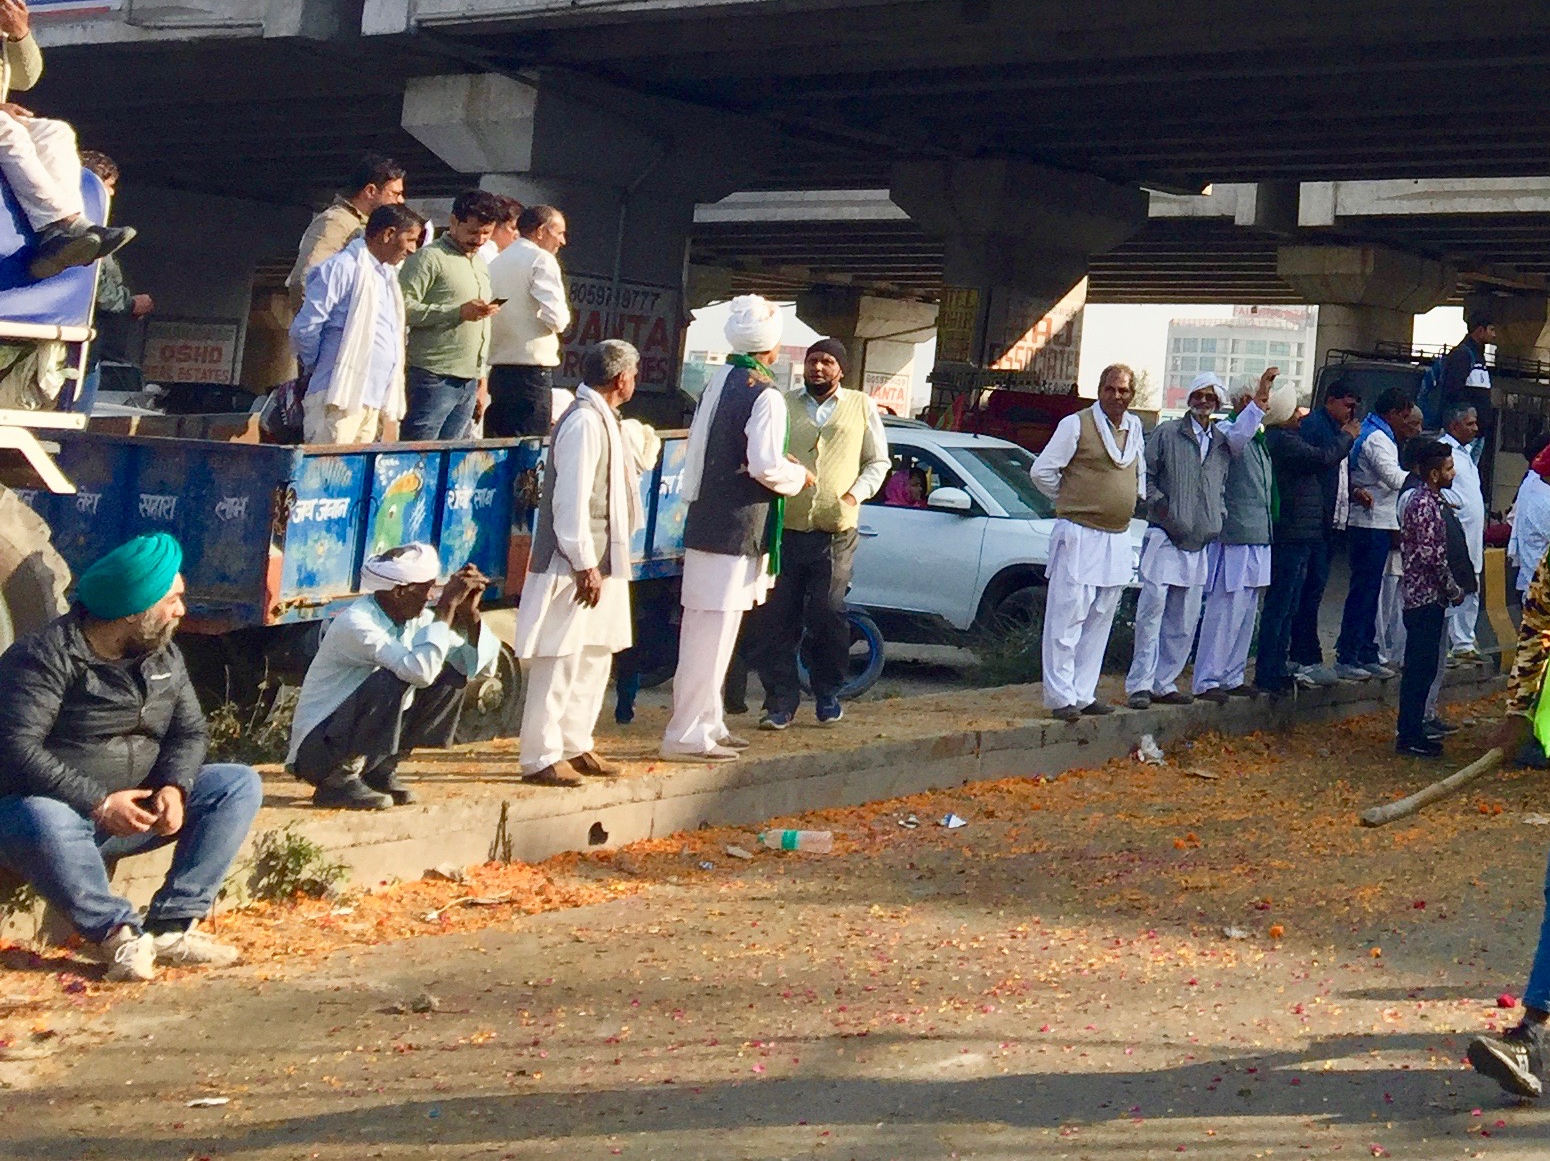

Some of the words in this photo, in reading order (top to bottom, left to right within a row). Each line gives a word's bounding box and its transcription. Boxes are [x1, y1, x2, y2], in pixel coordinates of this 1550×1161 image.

[562, 309, 672, 357] JANTA
[160, 343, 223, 364] OSHO
[177, 367, 230, 382] ESTATES
[138, 492, 179, 521] सहारा
